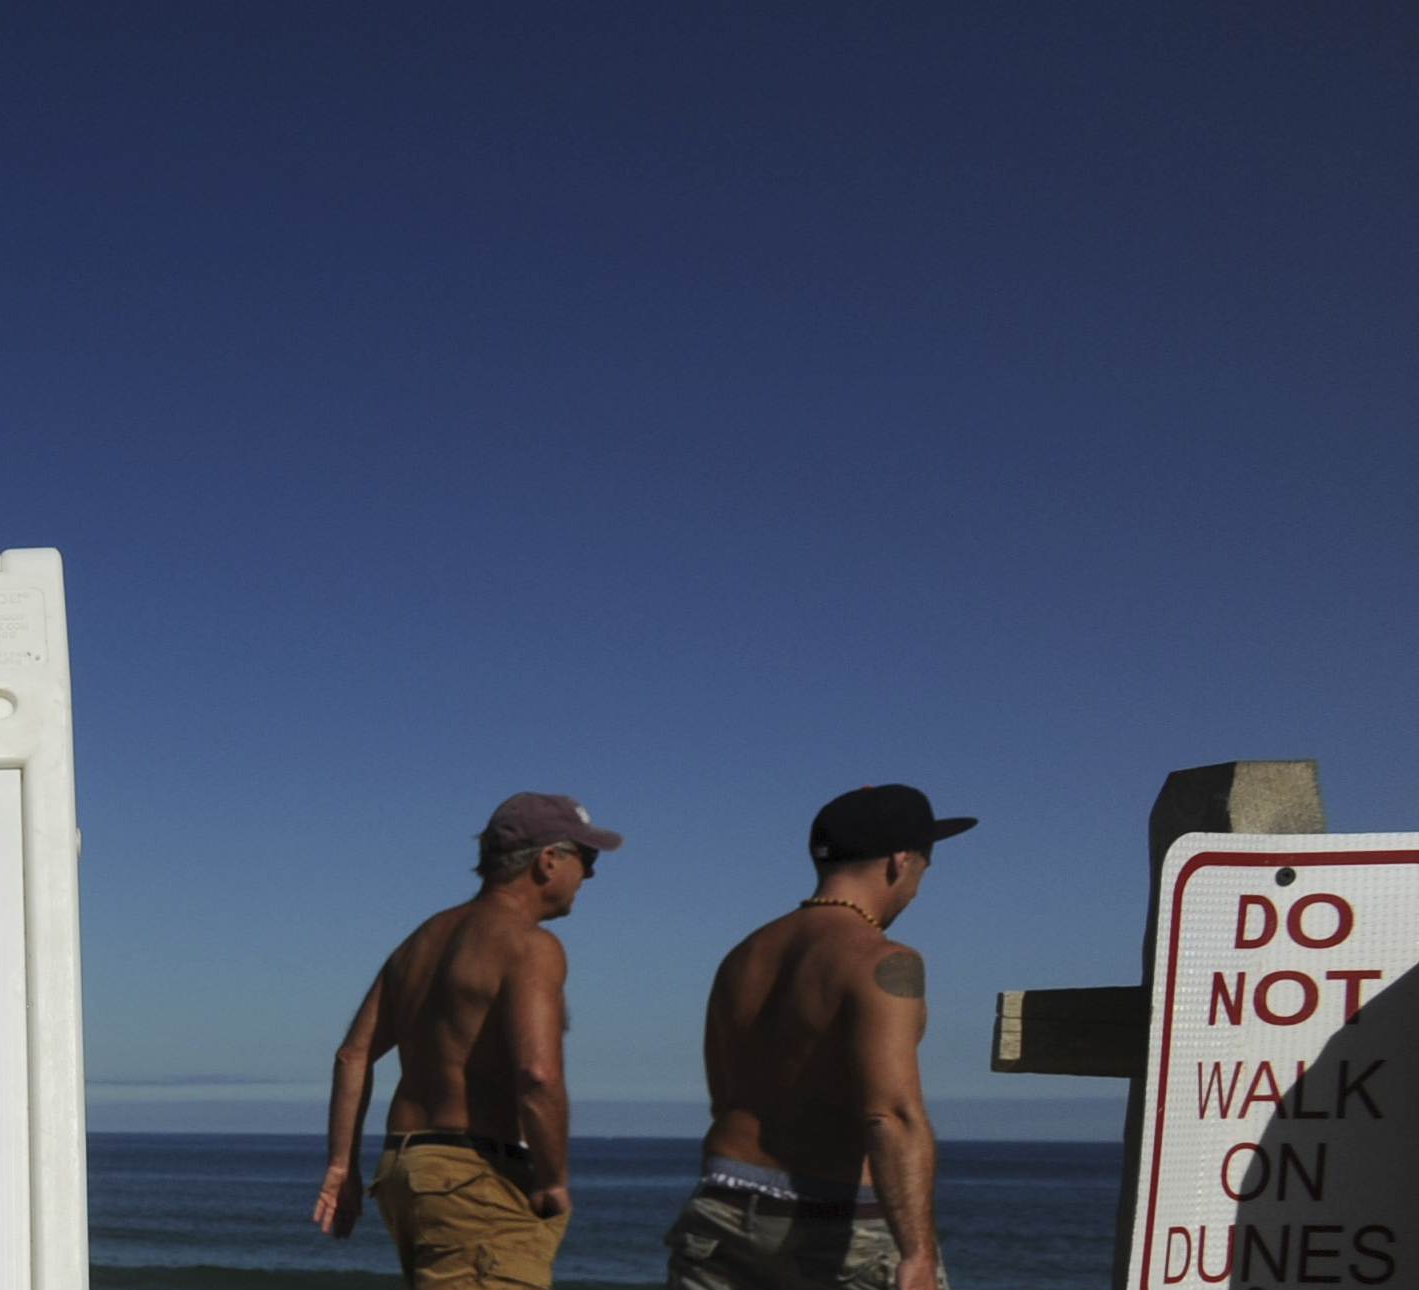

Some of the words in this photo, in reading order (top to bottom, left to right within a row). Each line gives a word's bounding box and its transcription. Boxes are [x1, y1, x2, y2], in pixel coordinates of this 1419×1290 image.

[1234, 892, 1355, 949] DO
[1207, 969, 1383, 1027] NOT
[1197, 1058, 1387, 1120] WALK
[1220, 1141, 1327, 1202] ON
[1163, 1224, 1396, 1286] DUNES
